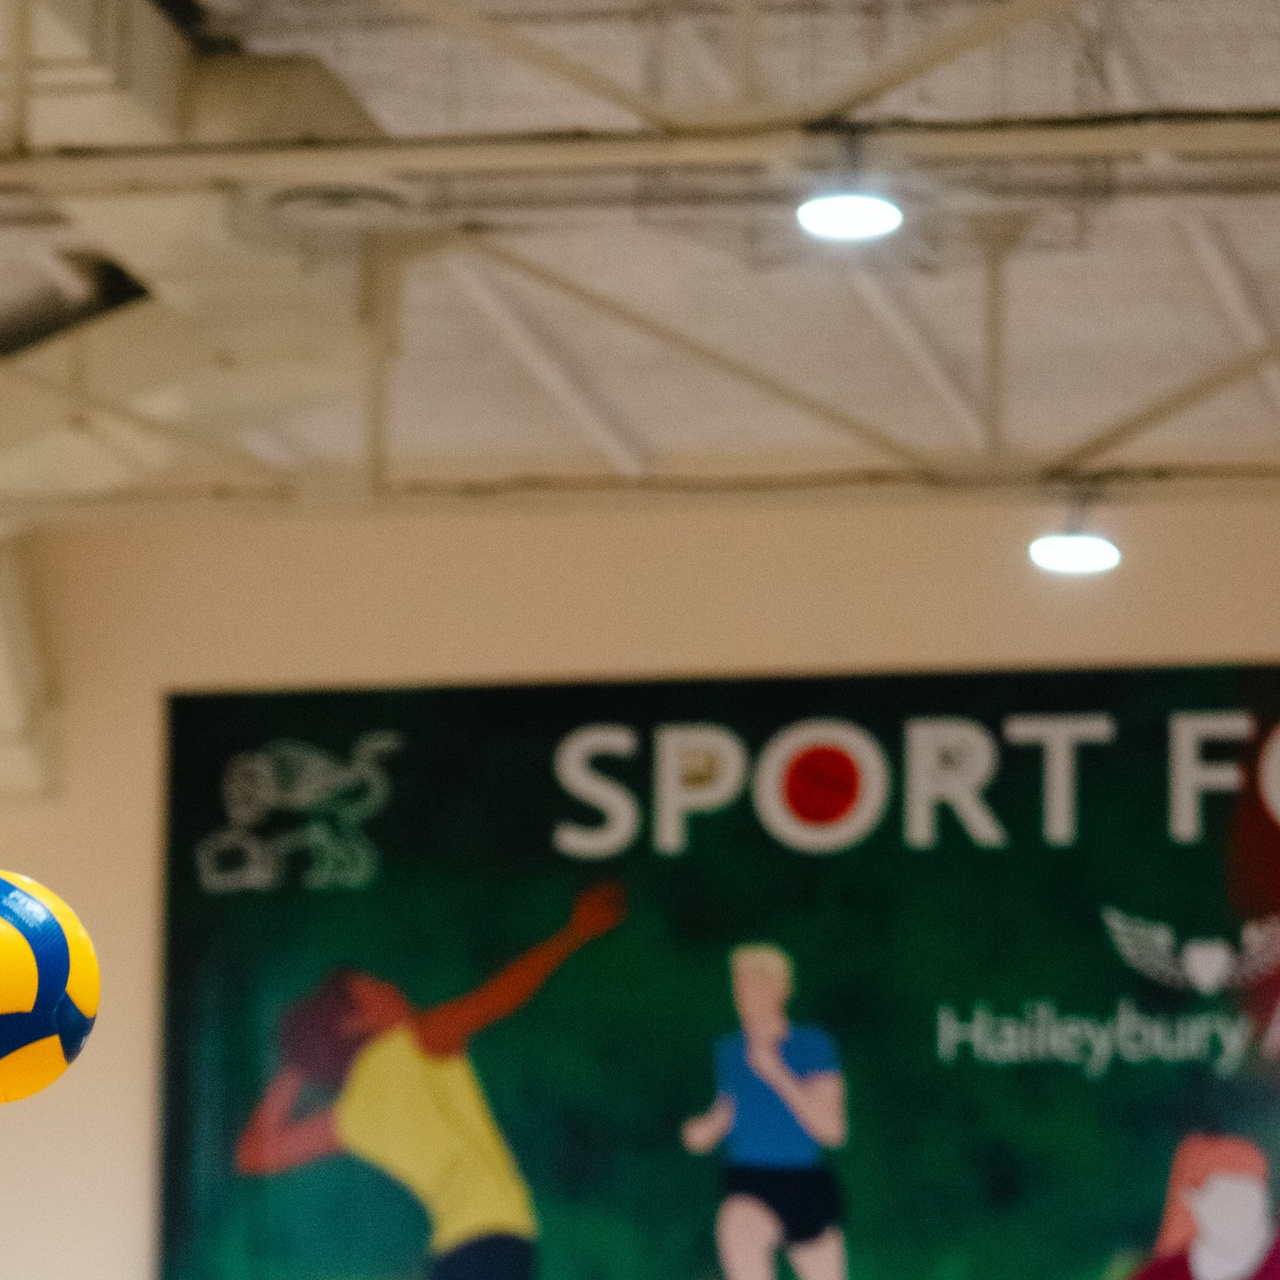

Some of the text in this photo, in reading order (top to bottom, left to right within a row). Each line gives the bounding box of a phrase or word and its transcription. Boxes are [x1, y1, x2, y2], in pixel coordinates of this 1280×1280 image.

[553, 710, 1280, 859] SPORT F
[937, 999, 1250, 1080] Haileybury
